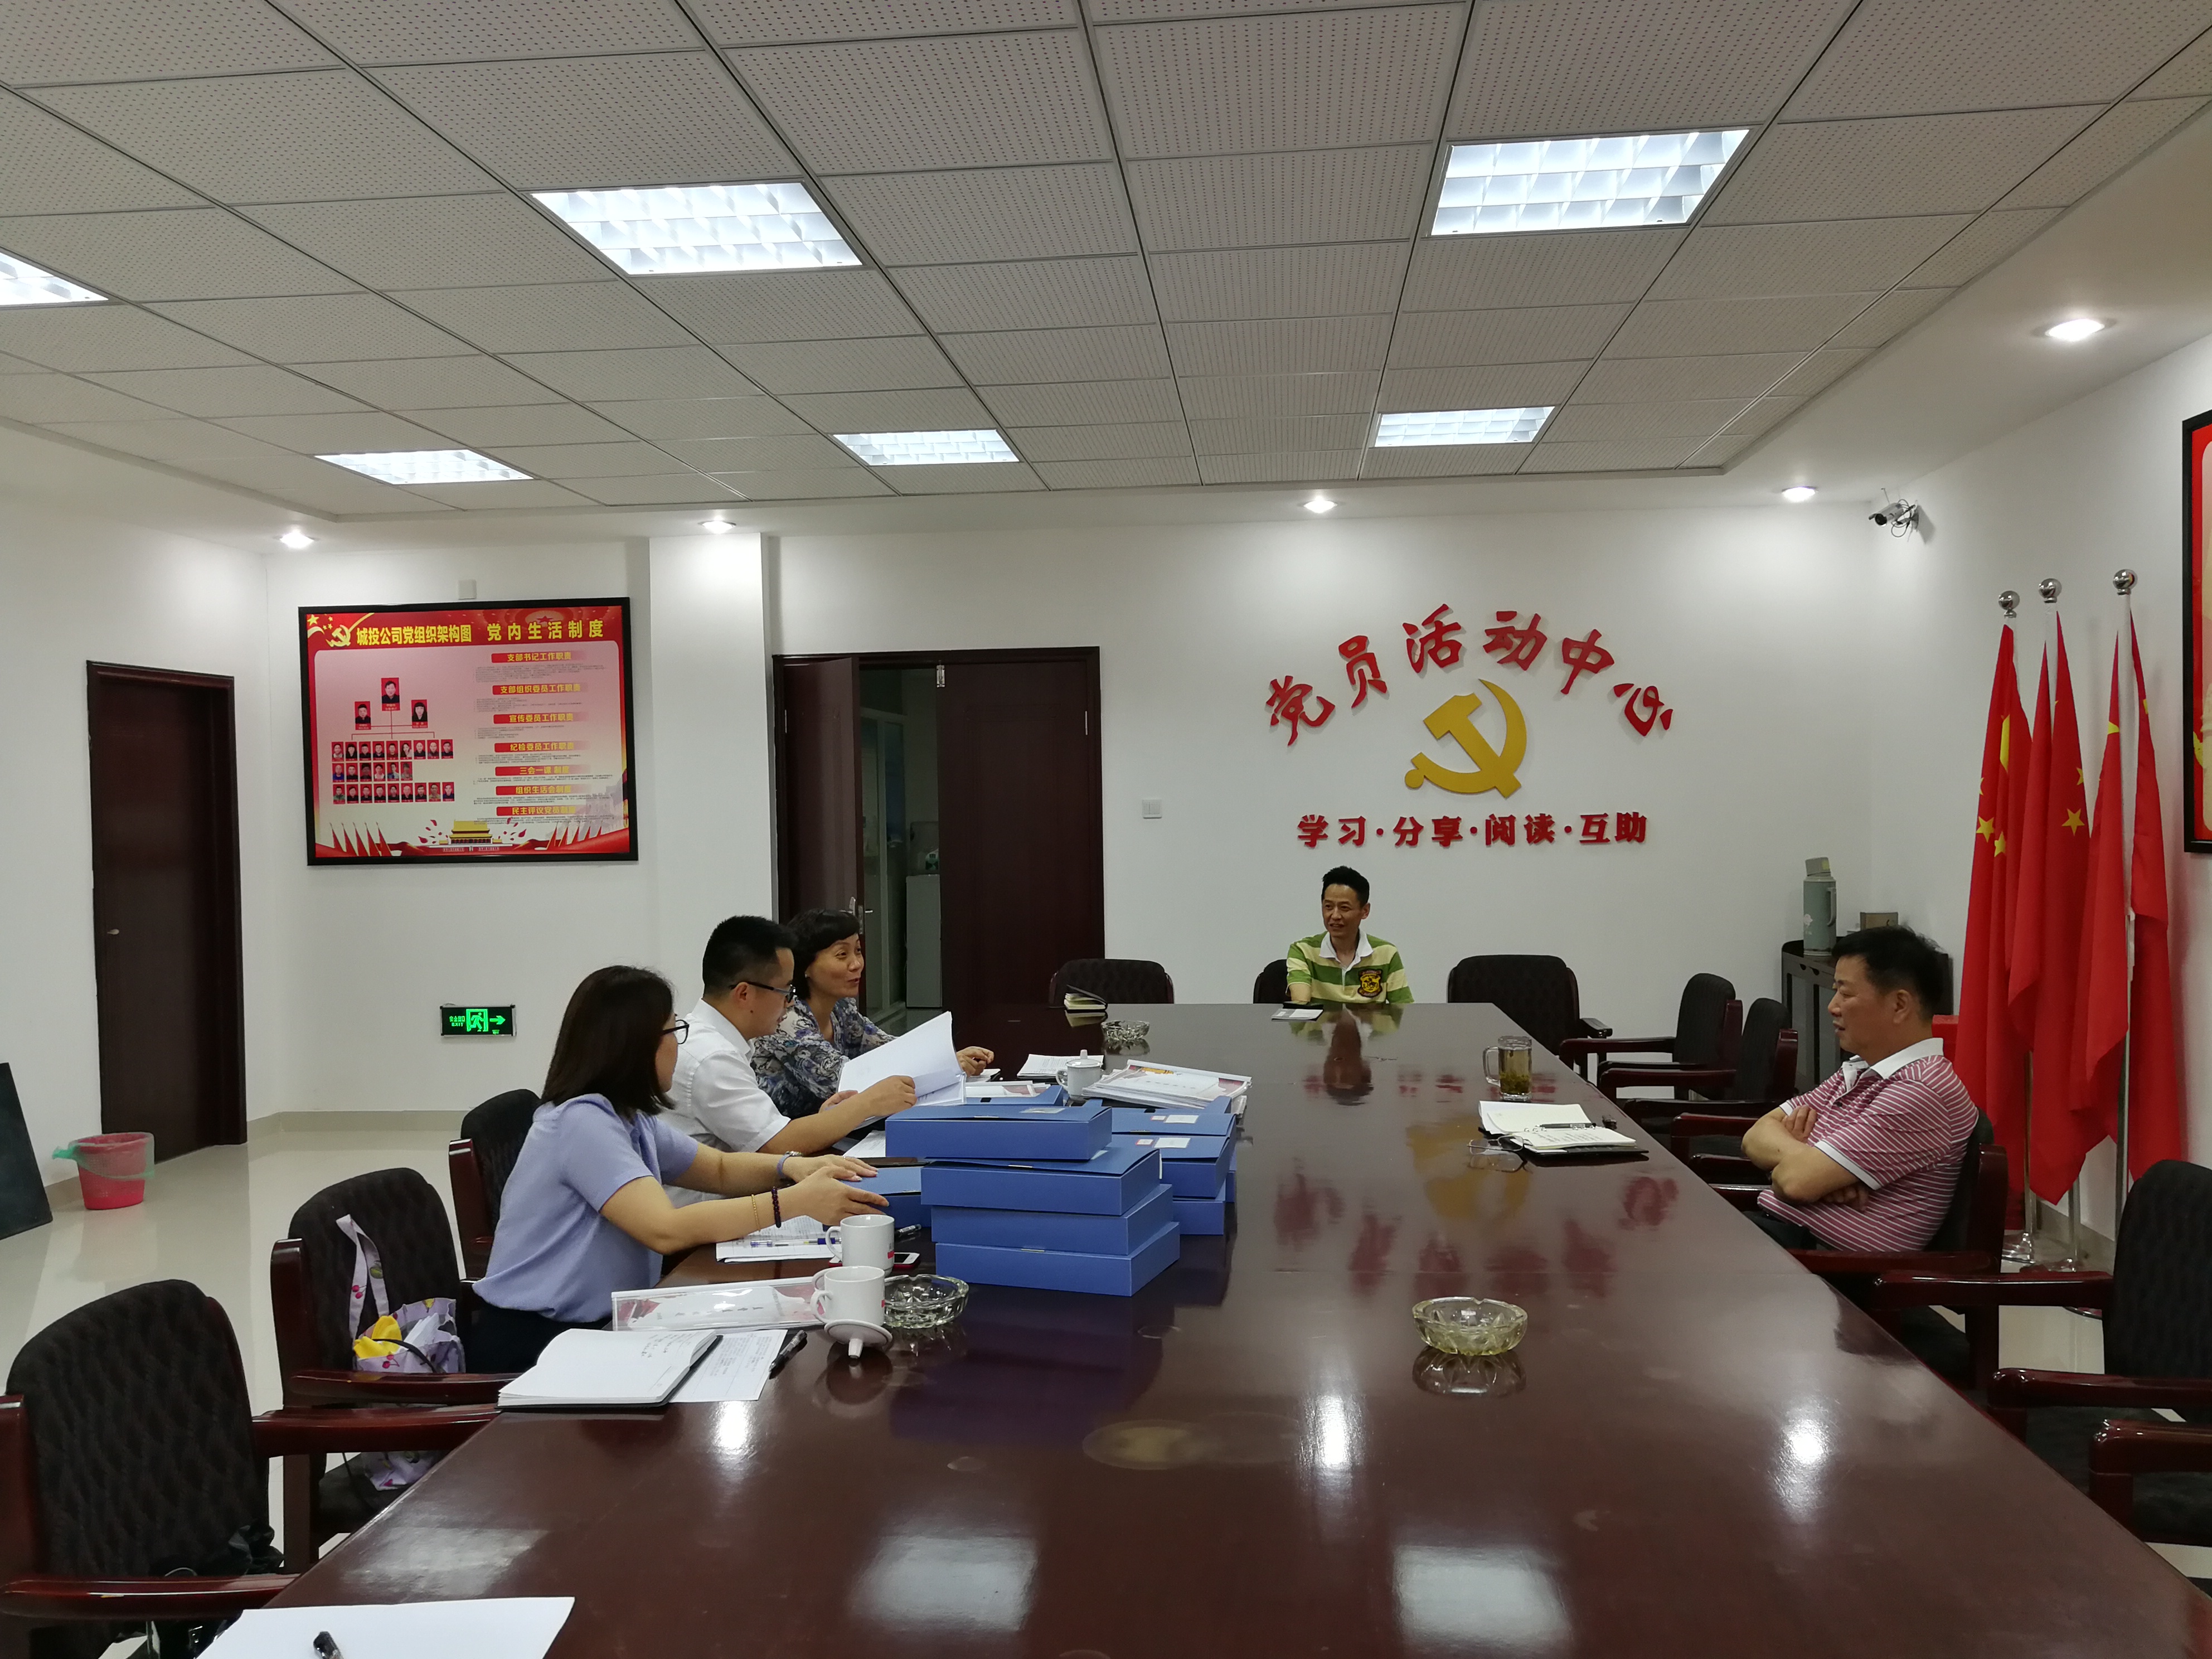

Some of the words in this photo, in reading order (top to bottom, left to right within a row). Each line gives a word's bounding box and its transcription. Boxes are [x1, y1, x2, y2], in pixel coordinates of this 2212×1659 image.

[356, 624, 472, 646] 城投公司党组织架构图
[487, 619, 604, 641] 党内生活制度
[507, 651, 571, 662] 支部书记工作职责
[1265, 603, 1673, 746] 党员活动中心
[500, 683, 580, 694] 支部组织委员工作职责
[509, 713, 574, 722] 宣传委员工作职责
[510, 741, 574, 751] 纪检委员工作职责
[515, 785, 571, 794] 组织生活会制度
[512, 806, 576, 816] 民主评议党员制度
